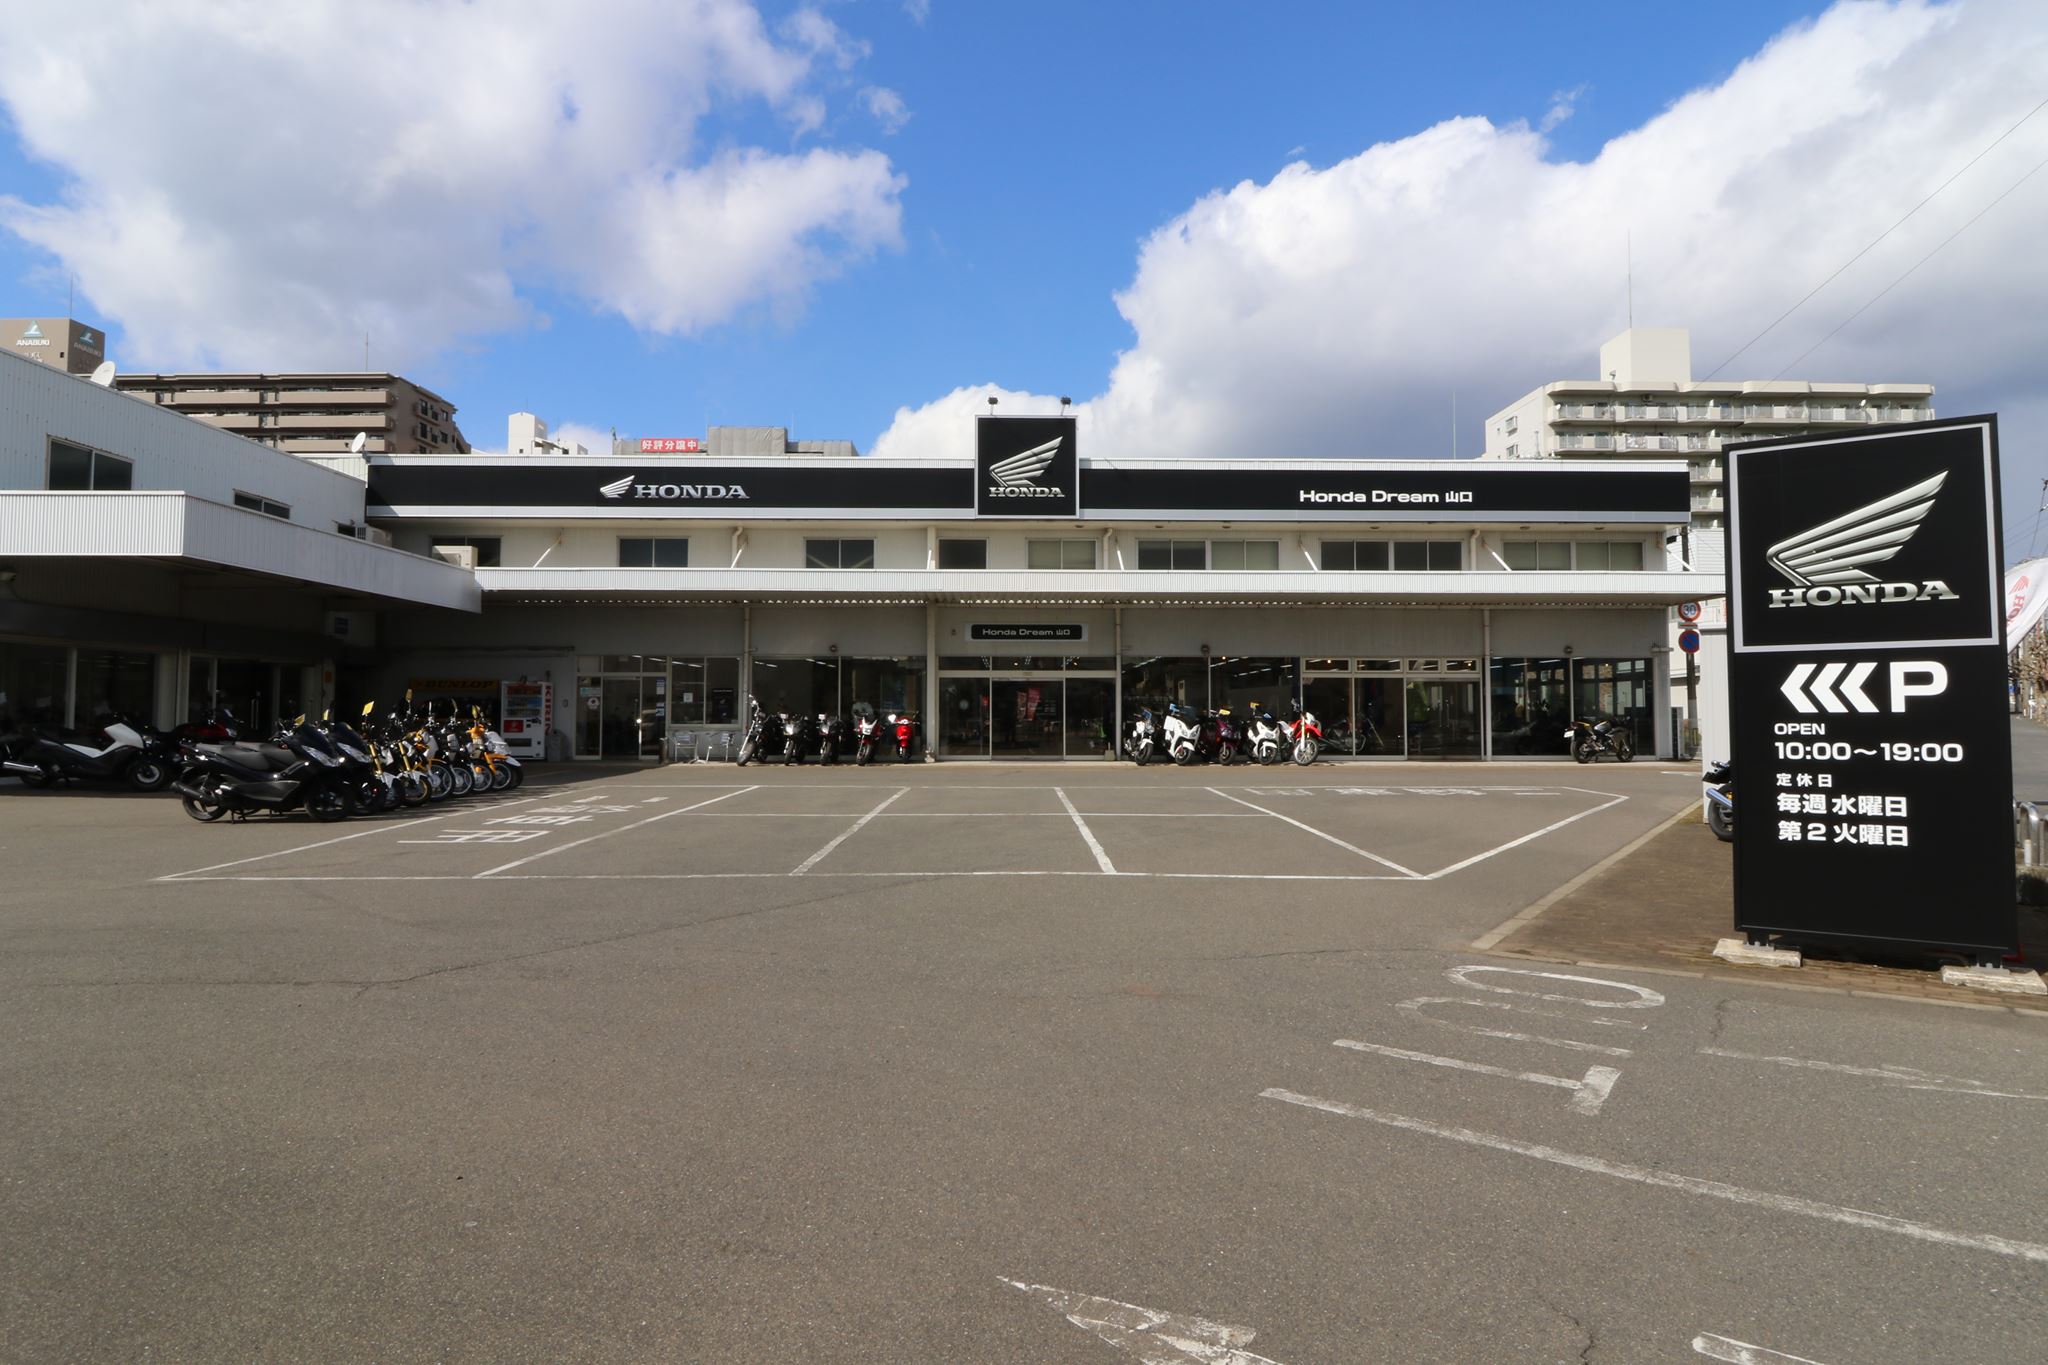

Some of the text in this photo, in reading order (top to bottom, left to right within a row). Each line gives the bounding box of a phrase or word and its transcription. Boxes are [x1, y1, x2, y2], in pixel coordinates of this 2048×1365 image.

[634, 484, 750, 499] HONDA
[989, 487, 1066, 498] HONDA
[1300, 490, 1473, 503] Honda Dream 山口
[1769, 580, 1960, 609] HONDA
[1683, 604, 1697, 616] 30
[1889, 660, 1949, 713] P
[1774, 723, 1826, 736] OPEN
[1776, 773, 1833, 788] 定休日
[1777, 793, 1908, 817] 毎週 水曜日
[1833, 823, 1909, 846] 火曜日
